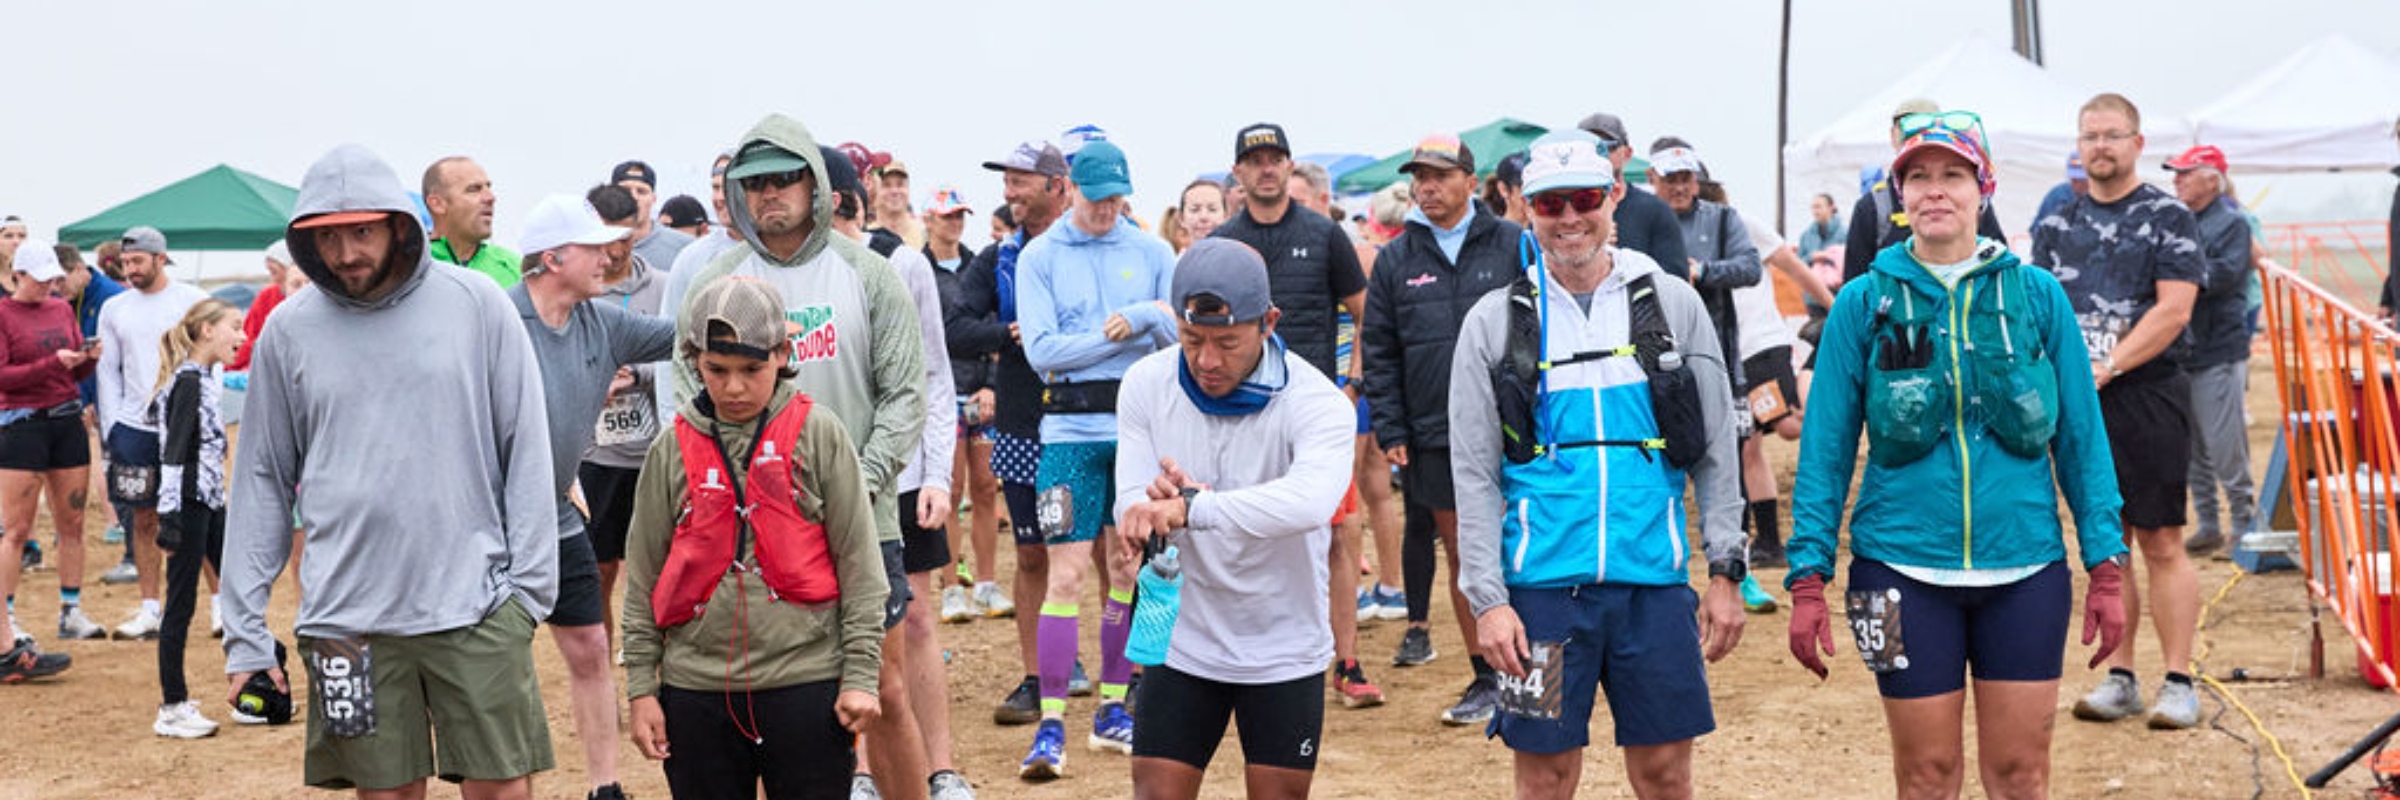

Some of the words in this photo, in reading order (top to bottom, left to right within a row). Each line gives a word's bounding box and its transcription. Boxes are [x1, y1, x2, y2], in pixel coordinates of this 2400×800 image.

[2081, 331, 2118, 352] 30
[603, 410, 642, 432] 569
[117, 476, 147, 494] 509
[1847, 619, 1886, 651] 35
[322, 656, 355, 719] 536
